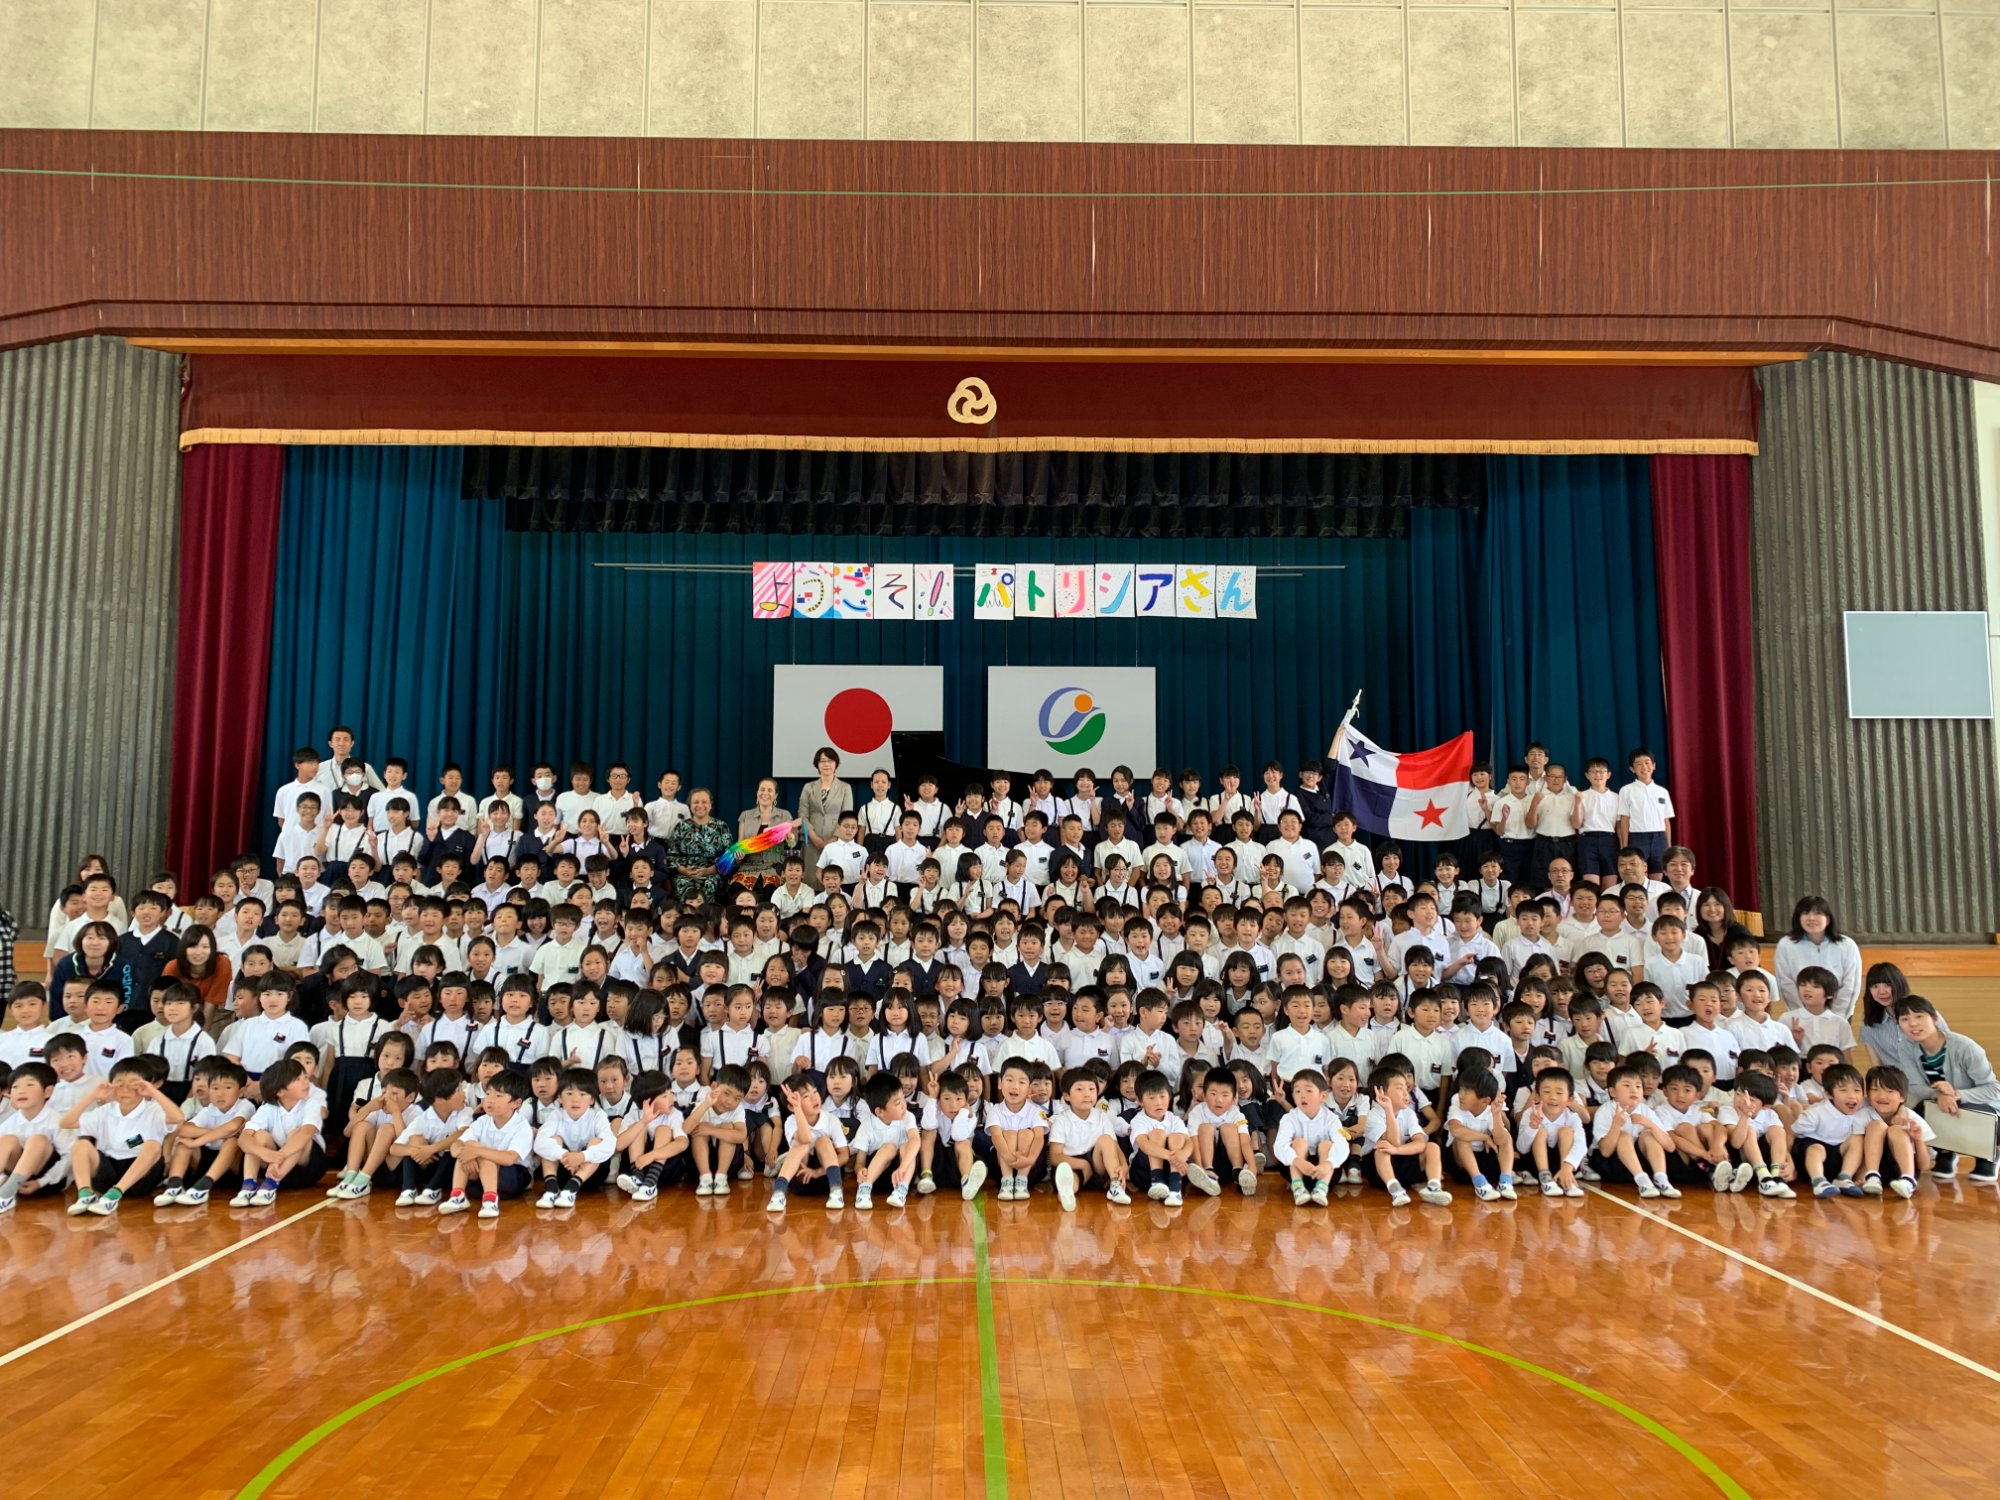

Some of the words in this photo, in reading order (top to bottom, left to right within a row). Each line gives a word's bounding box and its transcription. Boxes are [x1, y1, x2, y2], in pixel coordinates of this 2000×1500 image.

[976, 570, 1252, 613] パトリシアさん
